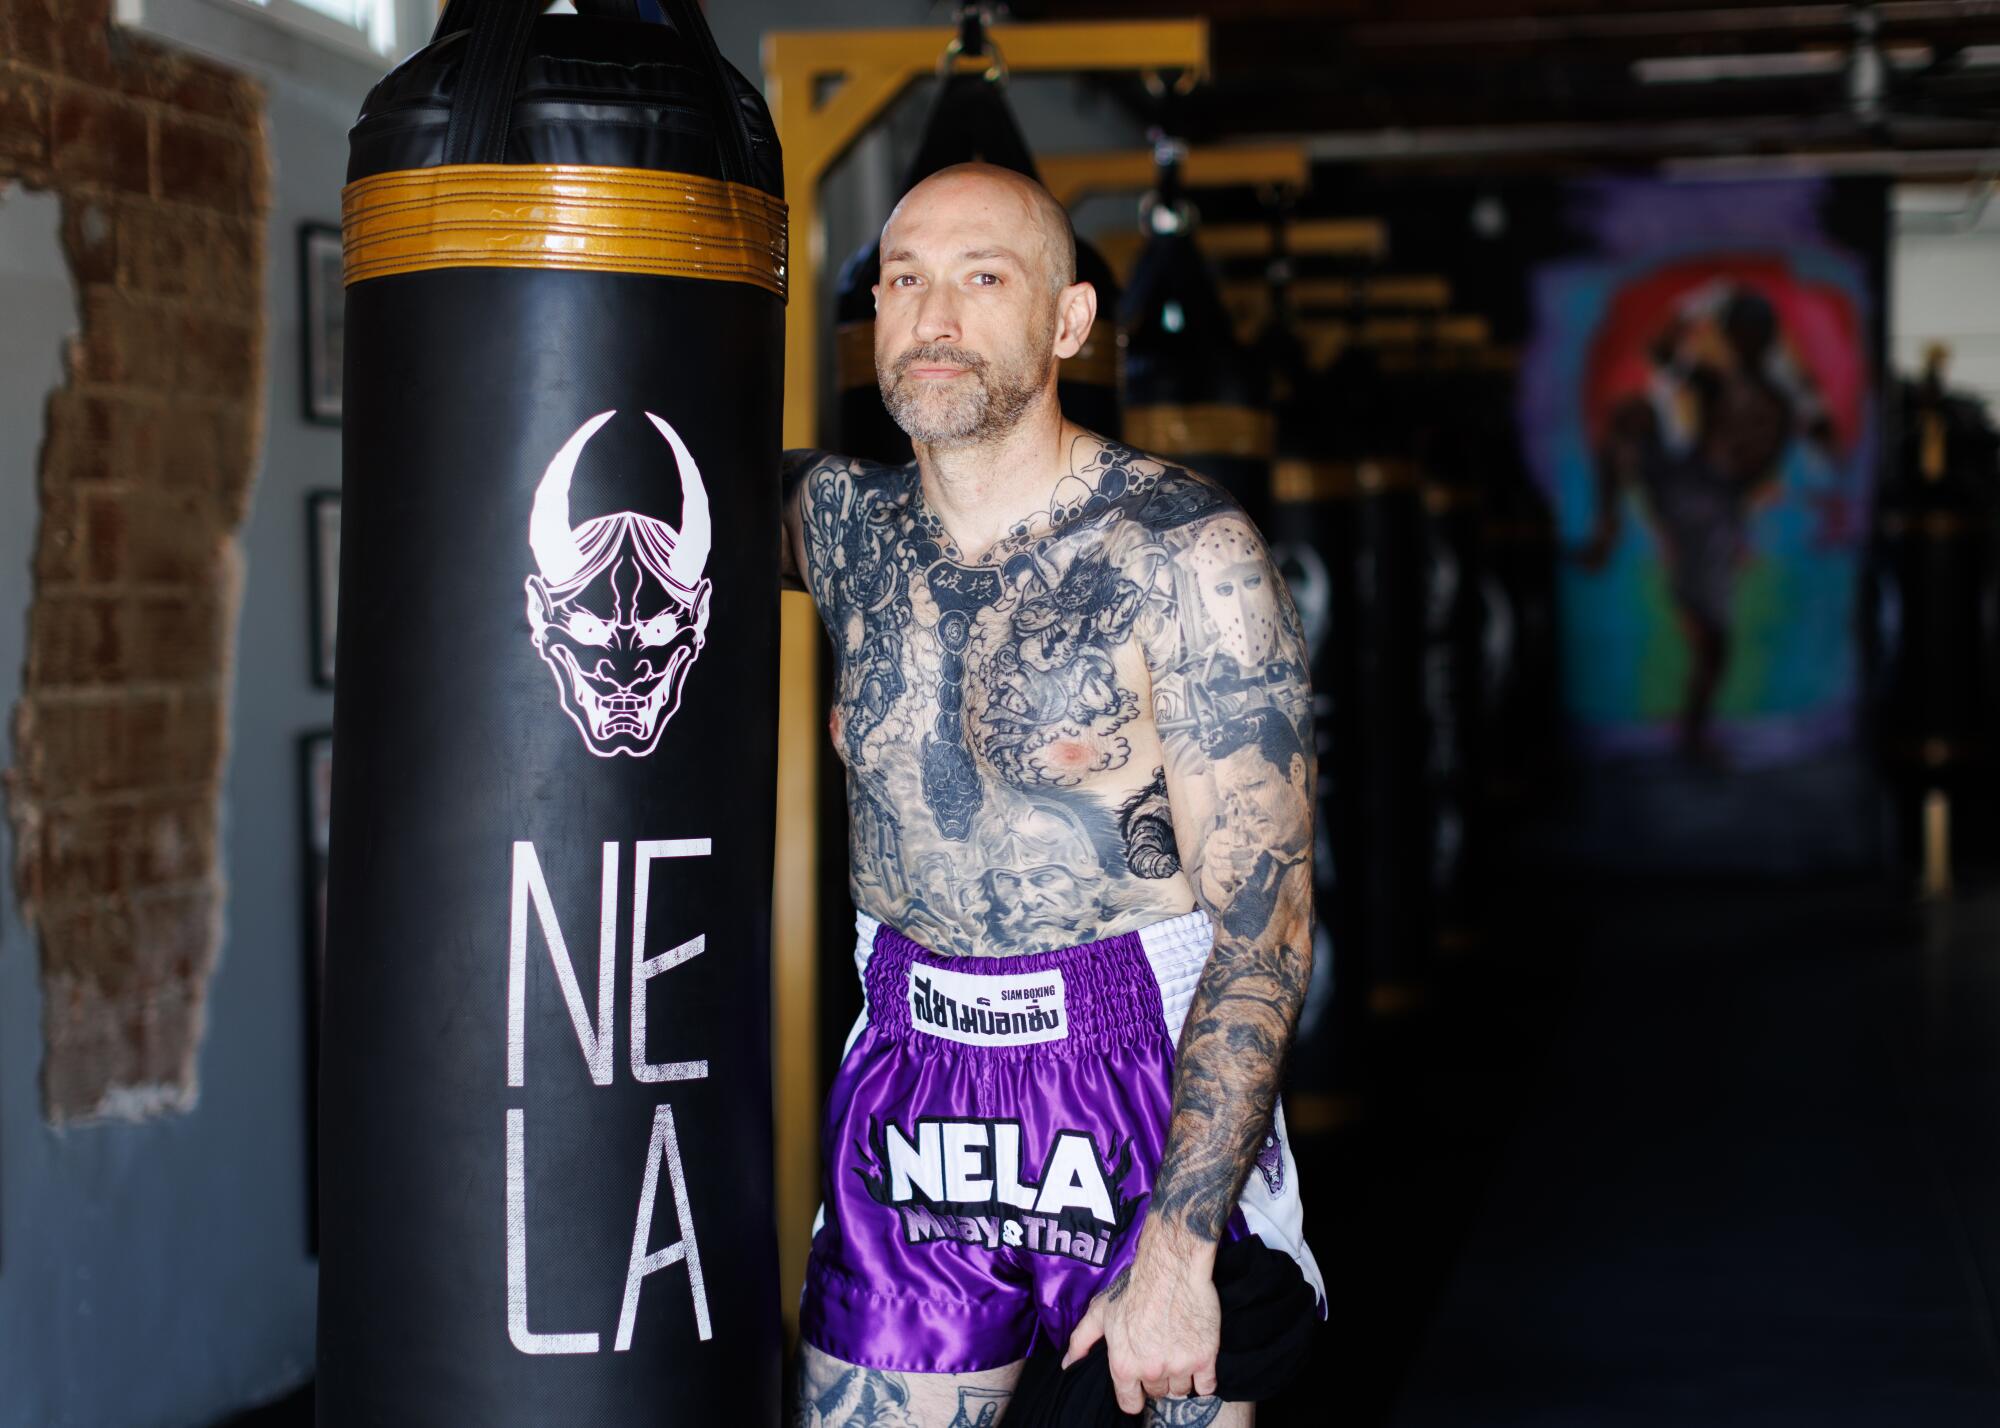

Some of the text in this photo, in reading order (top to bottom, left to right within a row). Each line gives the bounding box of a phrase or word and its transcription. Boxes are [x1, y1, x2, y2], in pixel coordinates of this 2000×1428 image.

[507, 838, 712, 1087] NE
[1001, 985, 1056, 1001] SIAM BOXING
[886, 1122, 1117, 1226] NELA
[507, 1104, 712, 1354] LA
[1021, 1214, 1111, 1265] Thai
